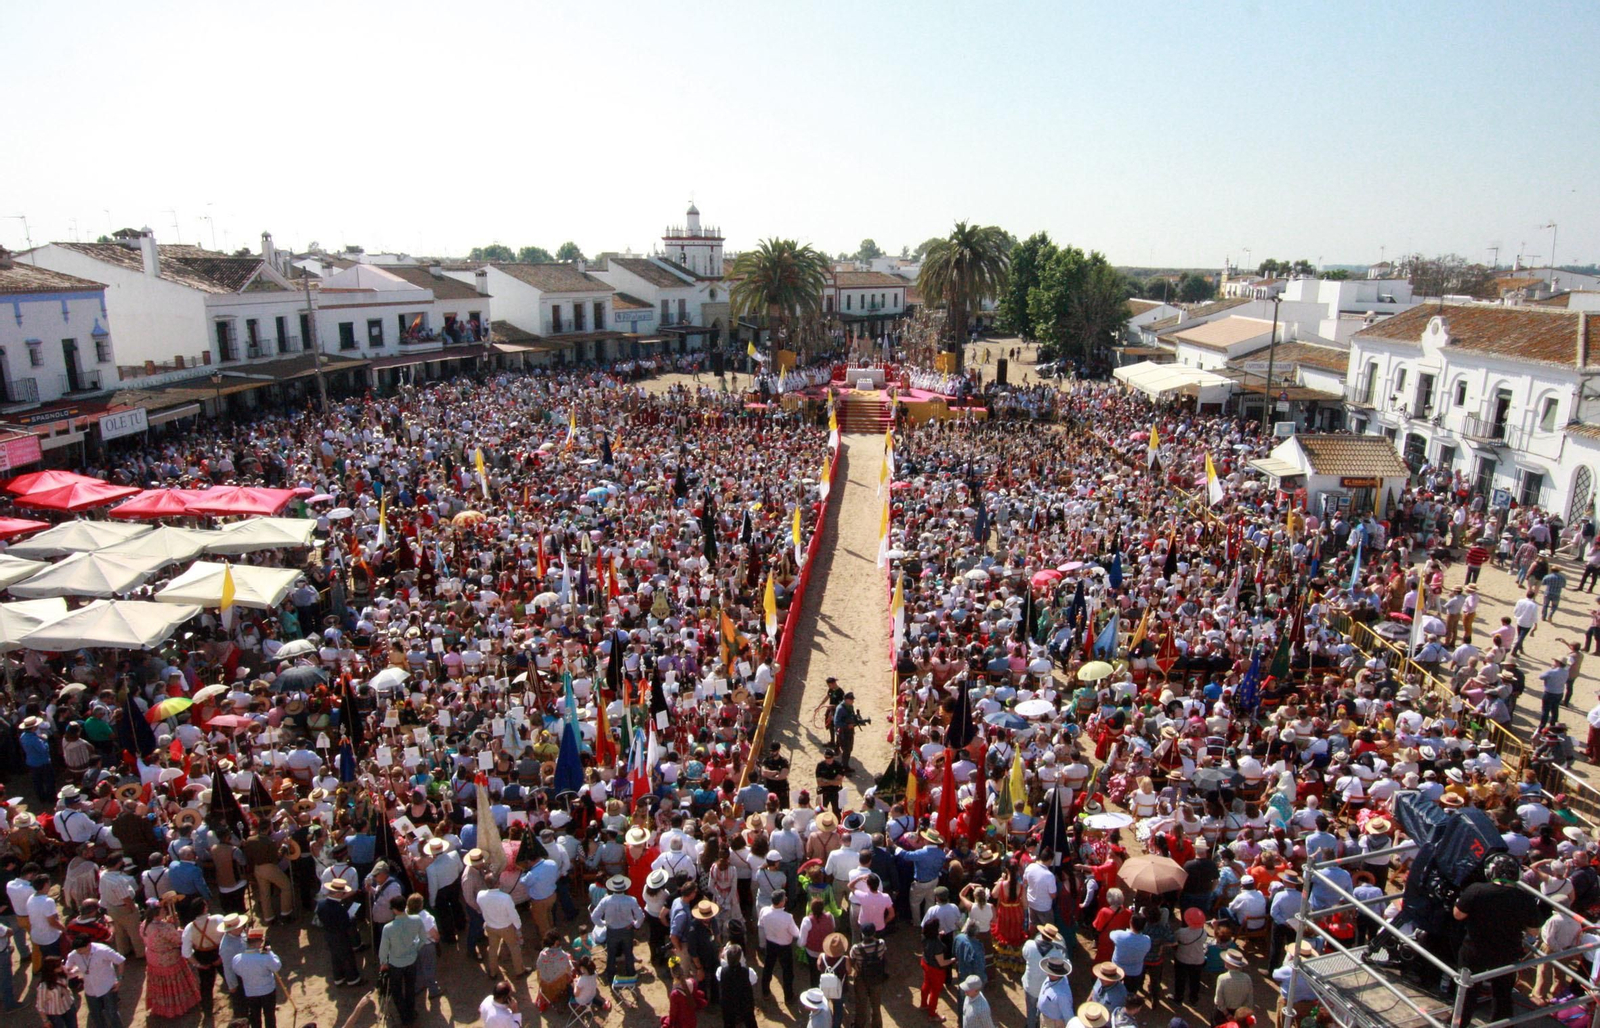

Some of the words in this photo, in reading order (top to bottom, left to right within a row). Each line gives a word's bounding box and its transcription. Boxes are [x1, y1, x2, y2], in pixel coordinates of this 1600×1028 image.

[31, 411, 69, 422] SPAGNOLO
[105, 415, 127, 432] OLE
[1496, 491, 1507, 506] P
[1470, 838, 1485, 858] T2
